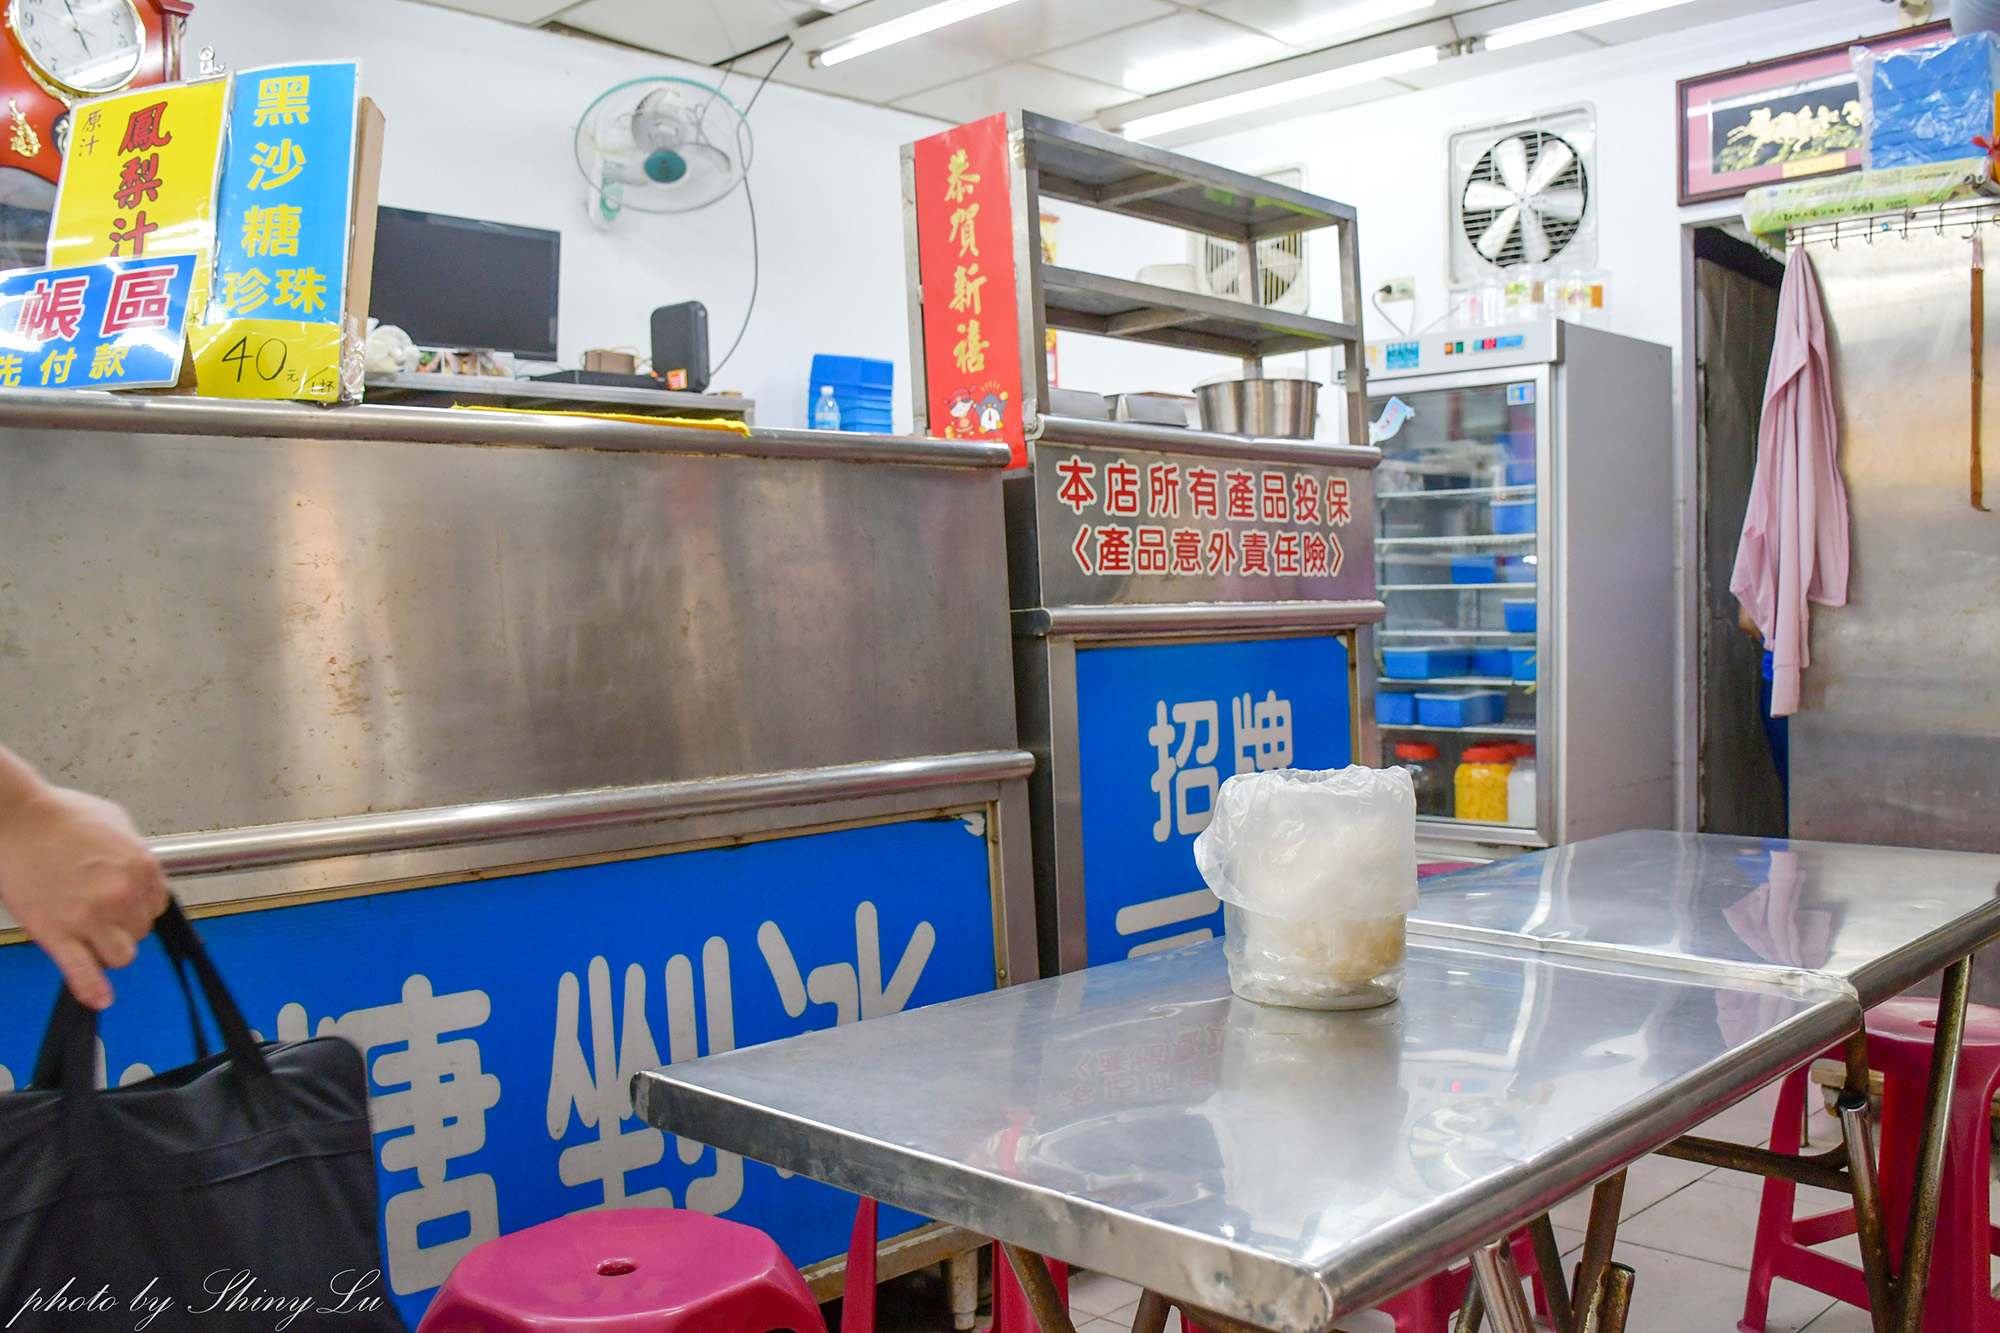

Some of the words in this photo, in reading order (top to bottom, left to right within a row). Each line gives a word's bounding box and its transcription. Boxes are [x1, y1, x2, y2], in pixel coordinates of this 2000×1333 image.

[79, 108, 102, 157] 原汁
[109, 101, 172, 259] 鳳梨汁
[944, 148, 990, 374] 恭賀新禧
[16, 263, 179, 343] 帳區
[0, 342, 129, 387] 先付款
[1055, 454, 1352, 526] 本店所有產品投保
